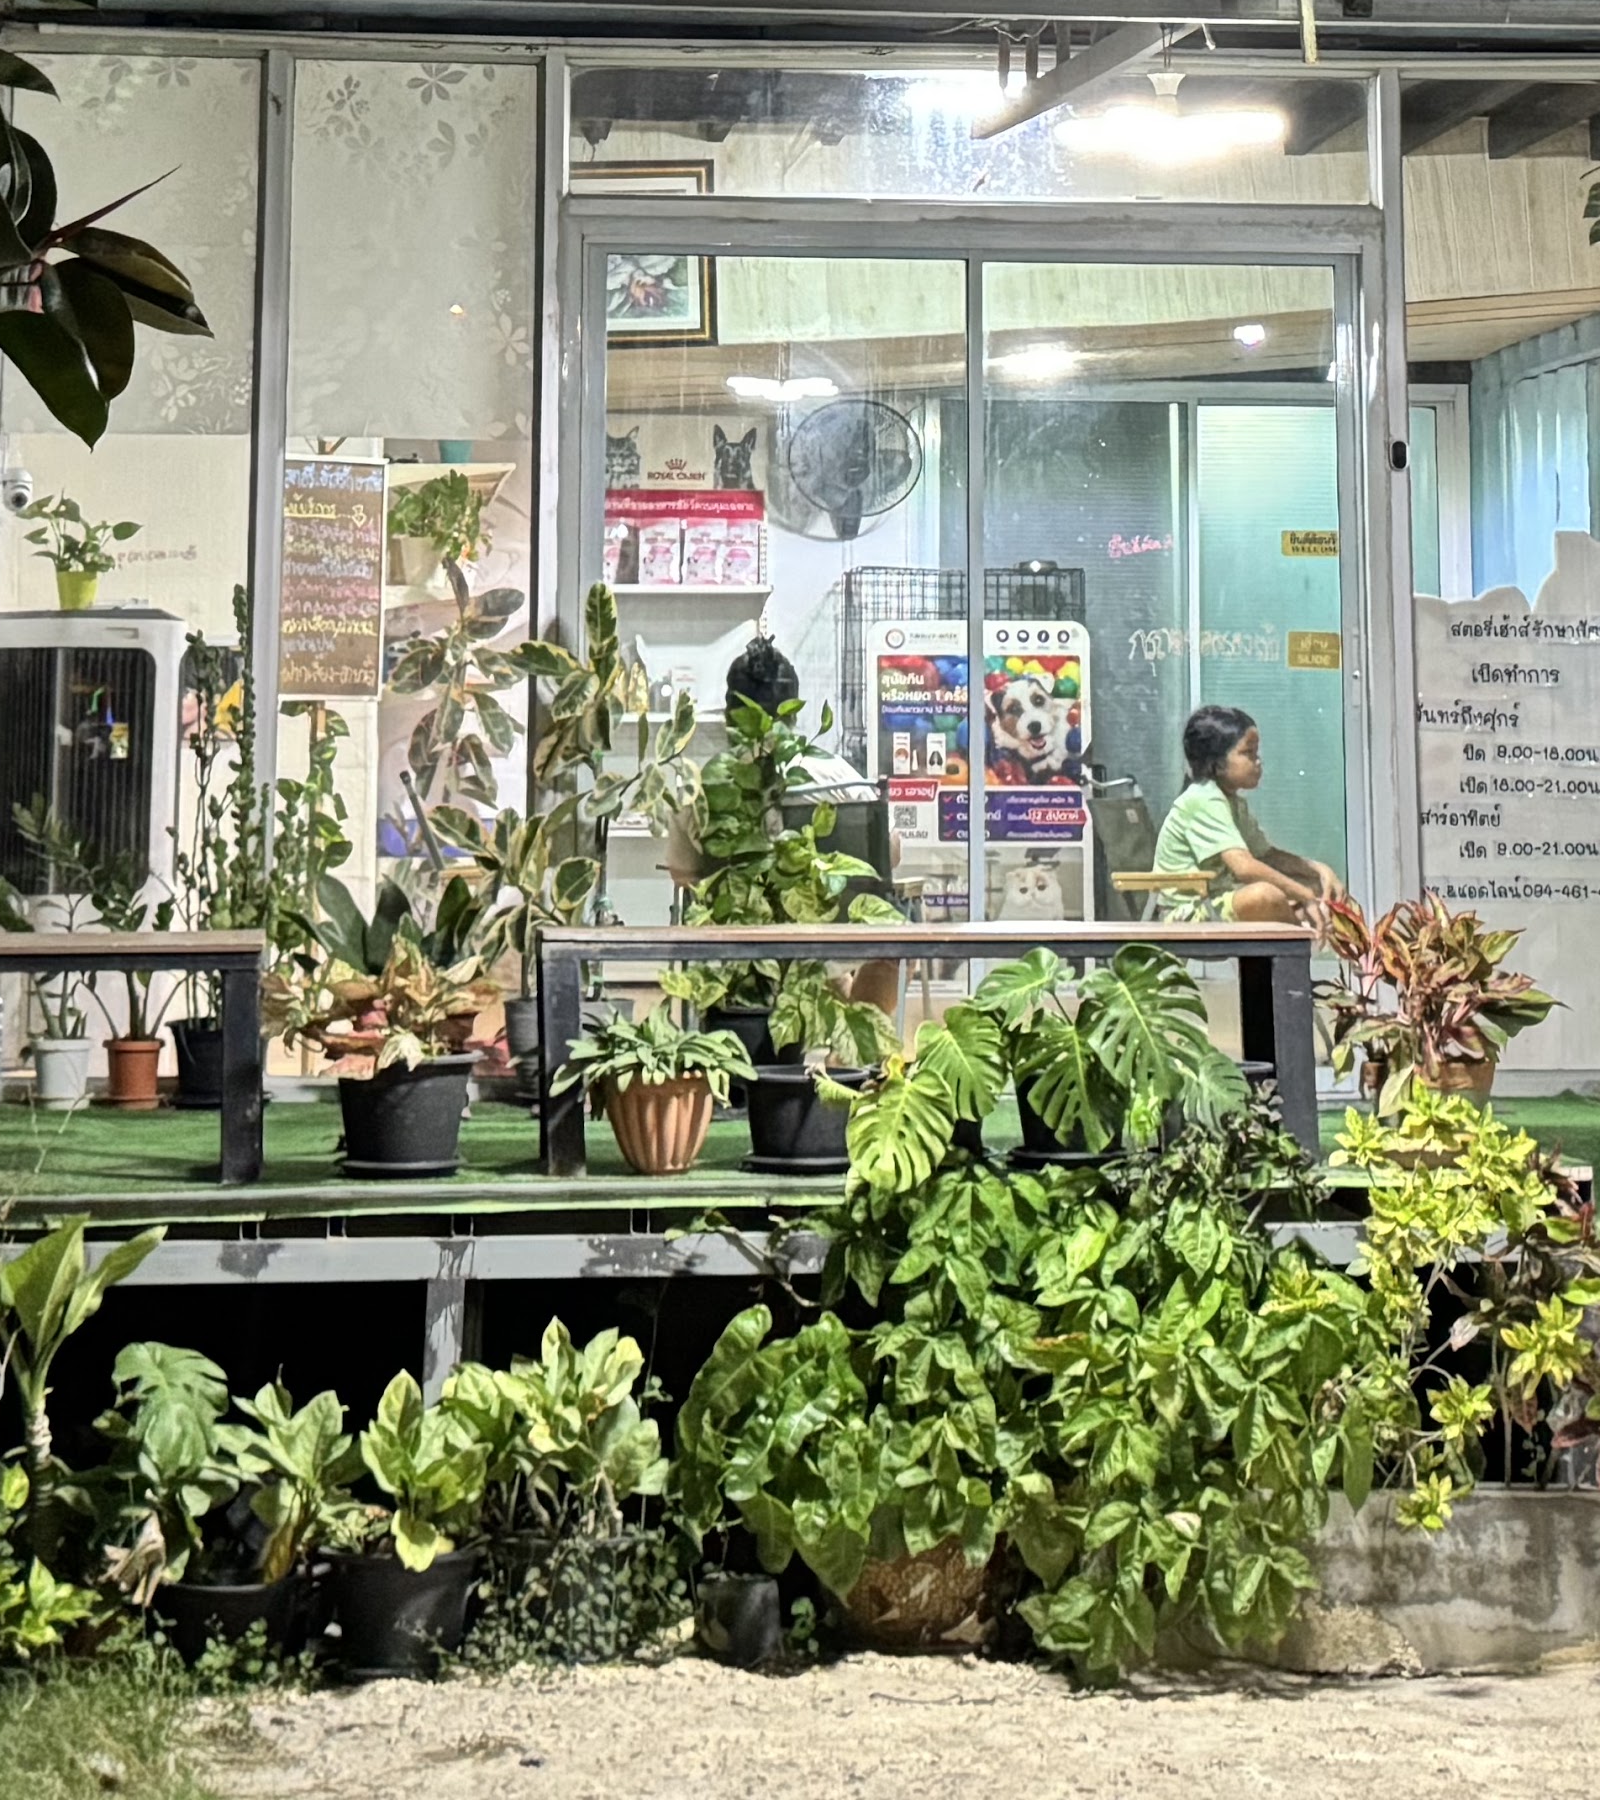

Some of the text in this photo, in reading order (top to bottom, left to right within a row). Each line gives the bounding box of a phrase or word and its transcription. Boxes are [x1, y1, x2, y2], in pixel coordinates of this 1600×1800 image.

[1471, 662, 1561, 684] เปิดทำการ
[1462, 743, 1486, 761] ปิด
[1459, 775, 1488, 794] เปิด
[1419, 802, 1502, 828] สาร์อาทิตย์
[1459, 840, 1487, 859] เปิด
